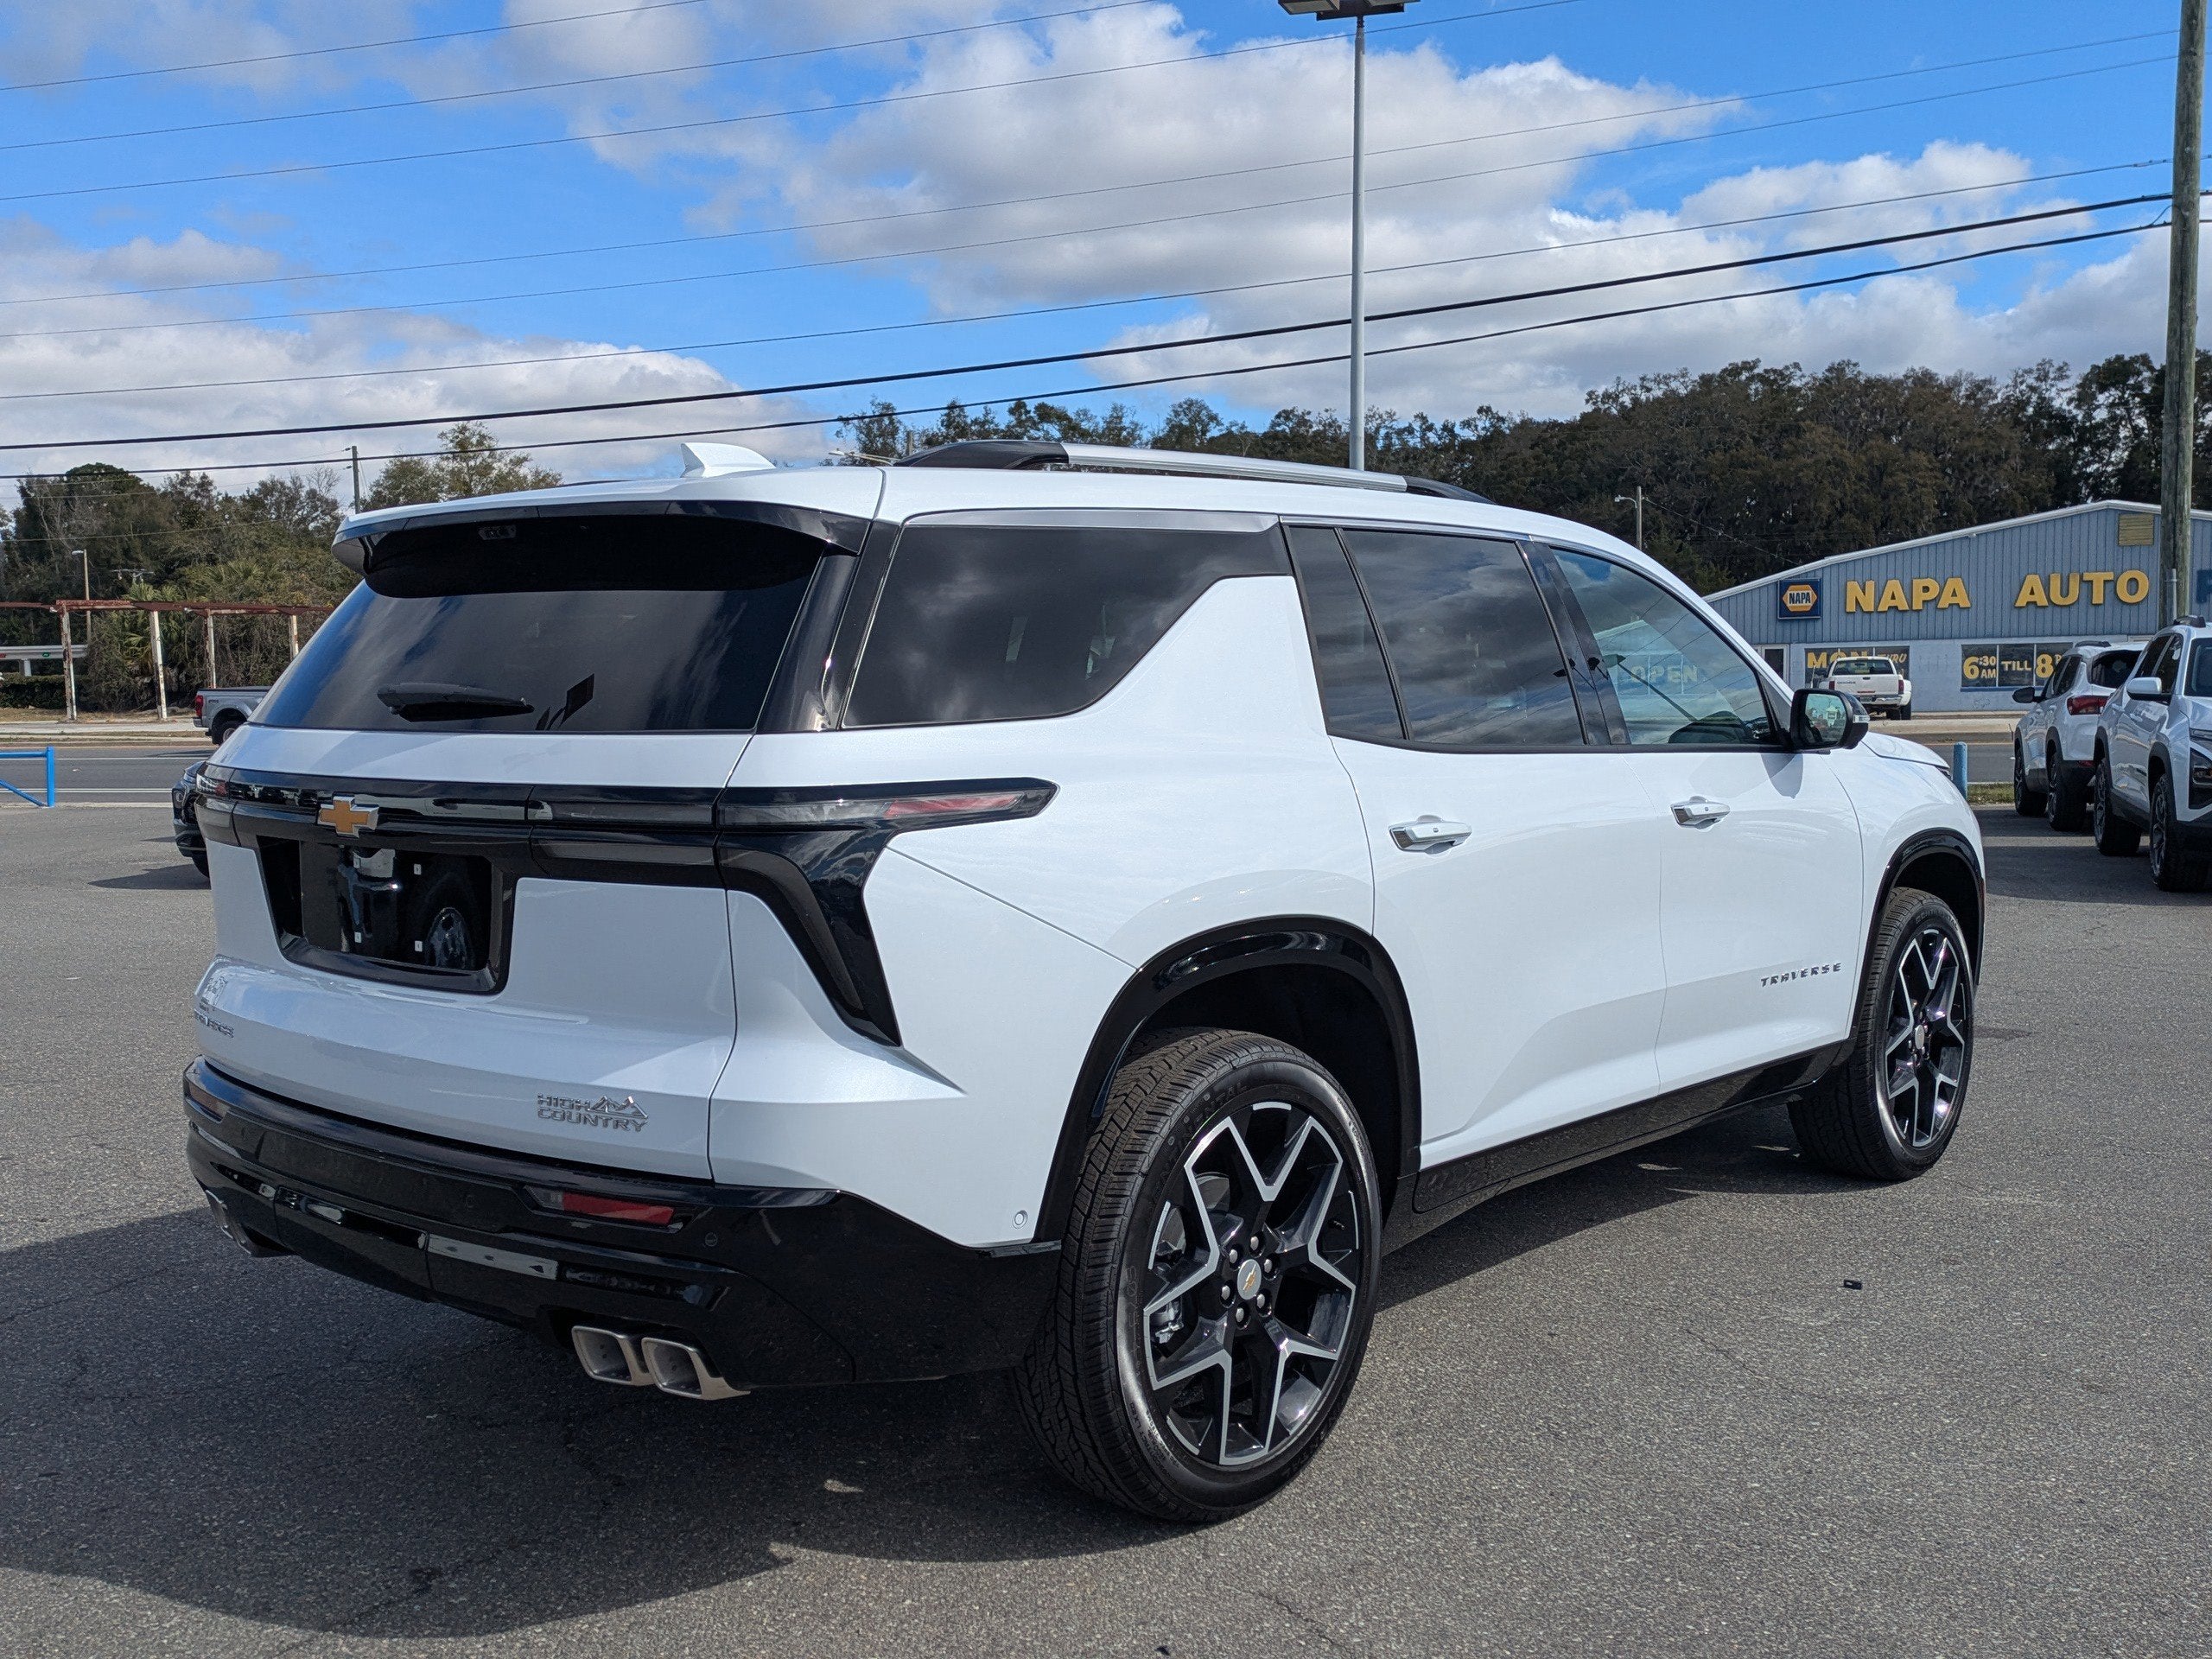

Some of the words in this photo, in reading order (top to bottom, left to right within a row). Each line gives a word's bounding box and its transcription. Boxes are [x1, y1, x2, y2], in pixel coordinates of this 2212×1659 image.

[1789, 591, 1811, 605] NAPA
[1846, 576, 1972, 613] NAPA
[2014, 569, 2150, 607] AUTO
[1630, 664, 1698, 683] OPEN
[1980, 669, 1997, 679] AM
[2001, 660, 2032, 671] TILL
[2035, 653, 2054, 678] 8
[1760, 963, 1841, 987] TRAVERSE
[537, 1093, 591, 1111] HIGH
[537, 1108, 648, 1133] COUNTRY
